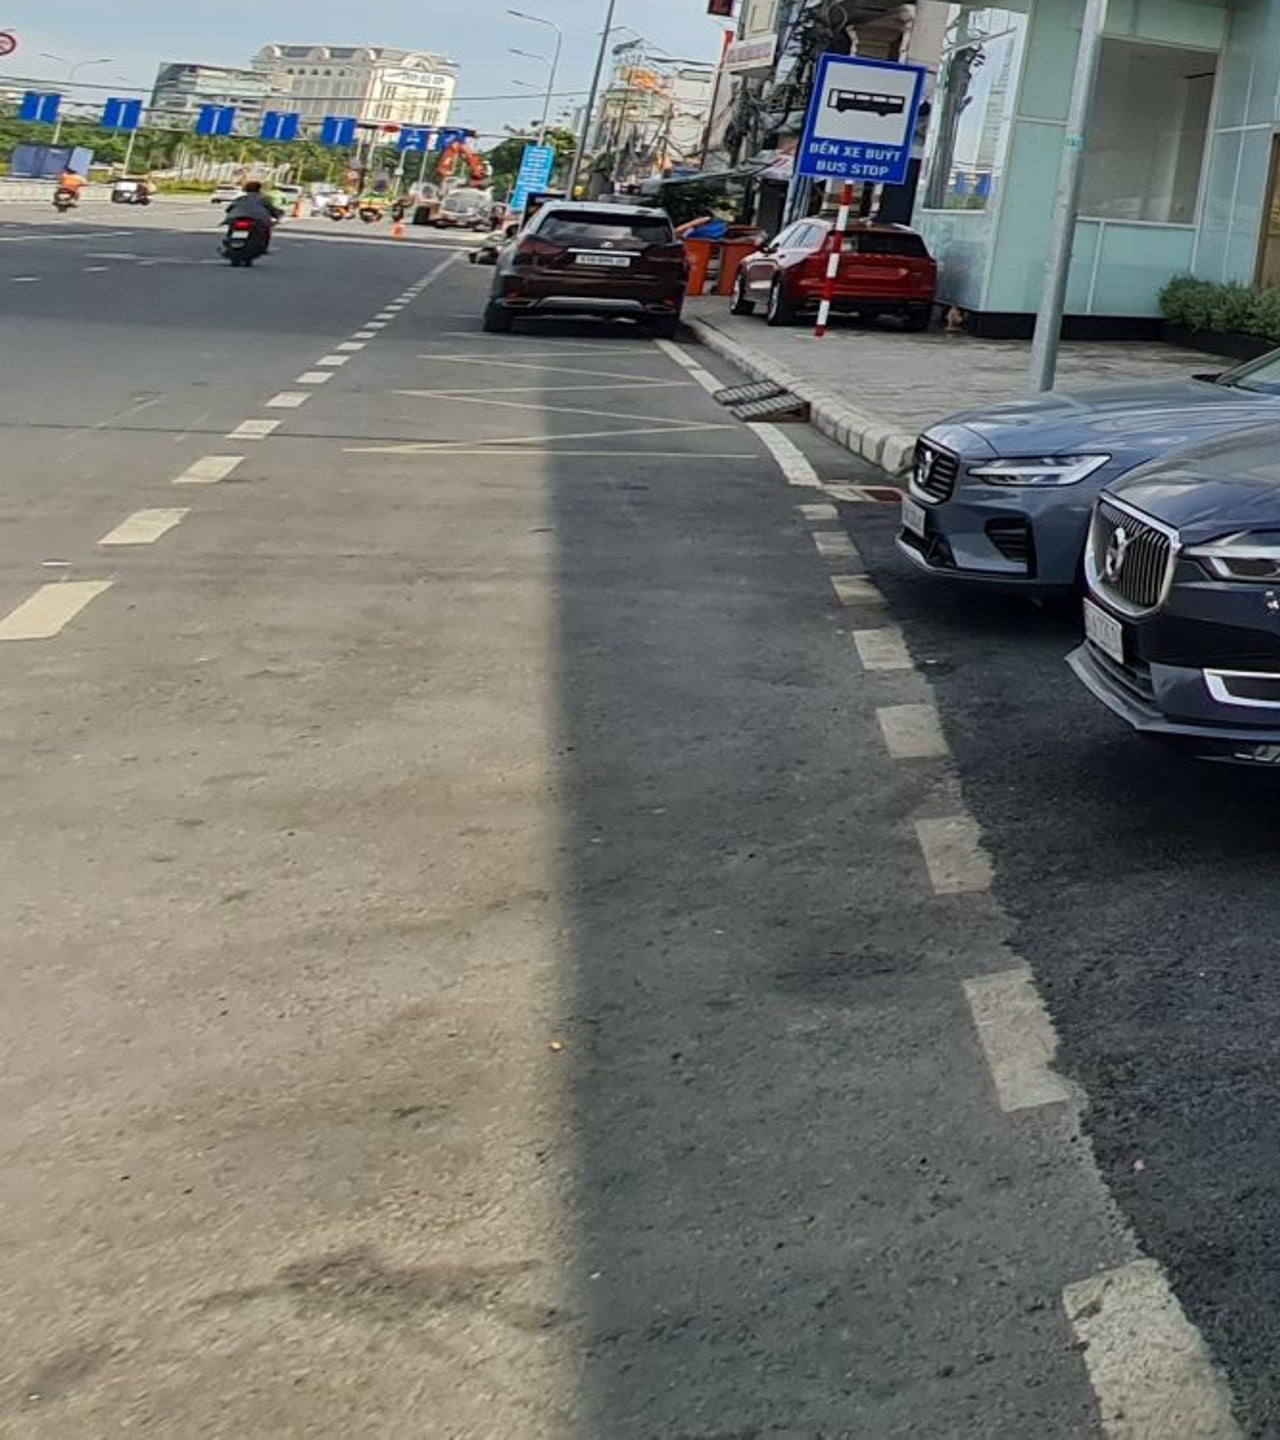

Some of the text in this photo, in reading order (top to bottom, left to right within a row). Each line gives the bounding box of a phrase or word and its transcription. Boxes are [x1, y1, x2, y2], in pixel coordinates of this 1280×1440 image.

[842, 146, 863, 159] XE
[815, 160, 890, 177] BUS STOP
